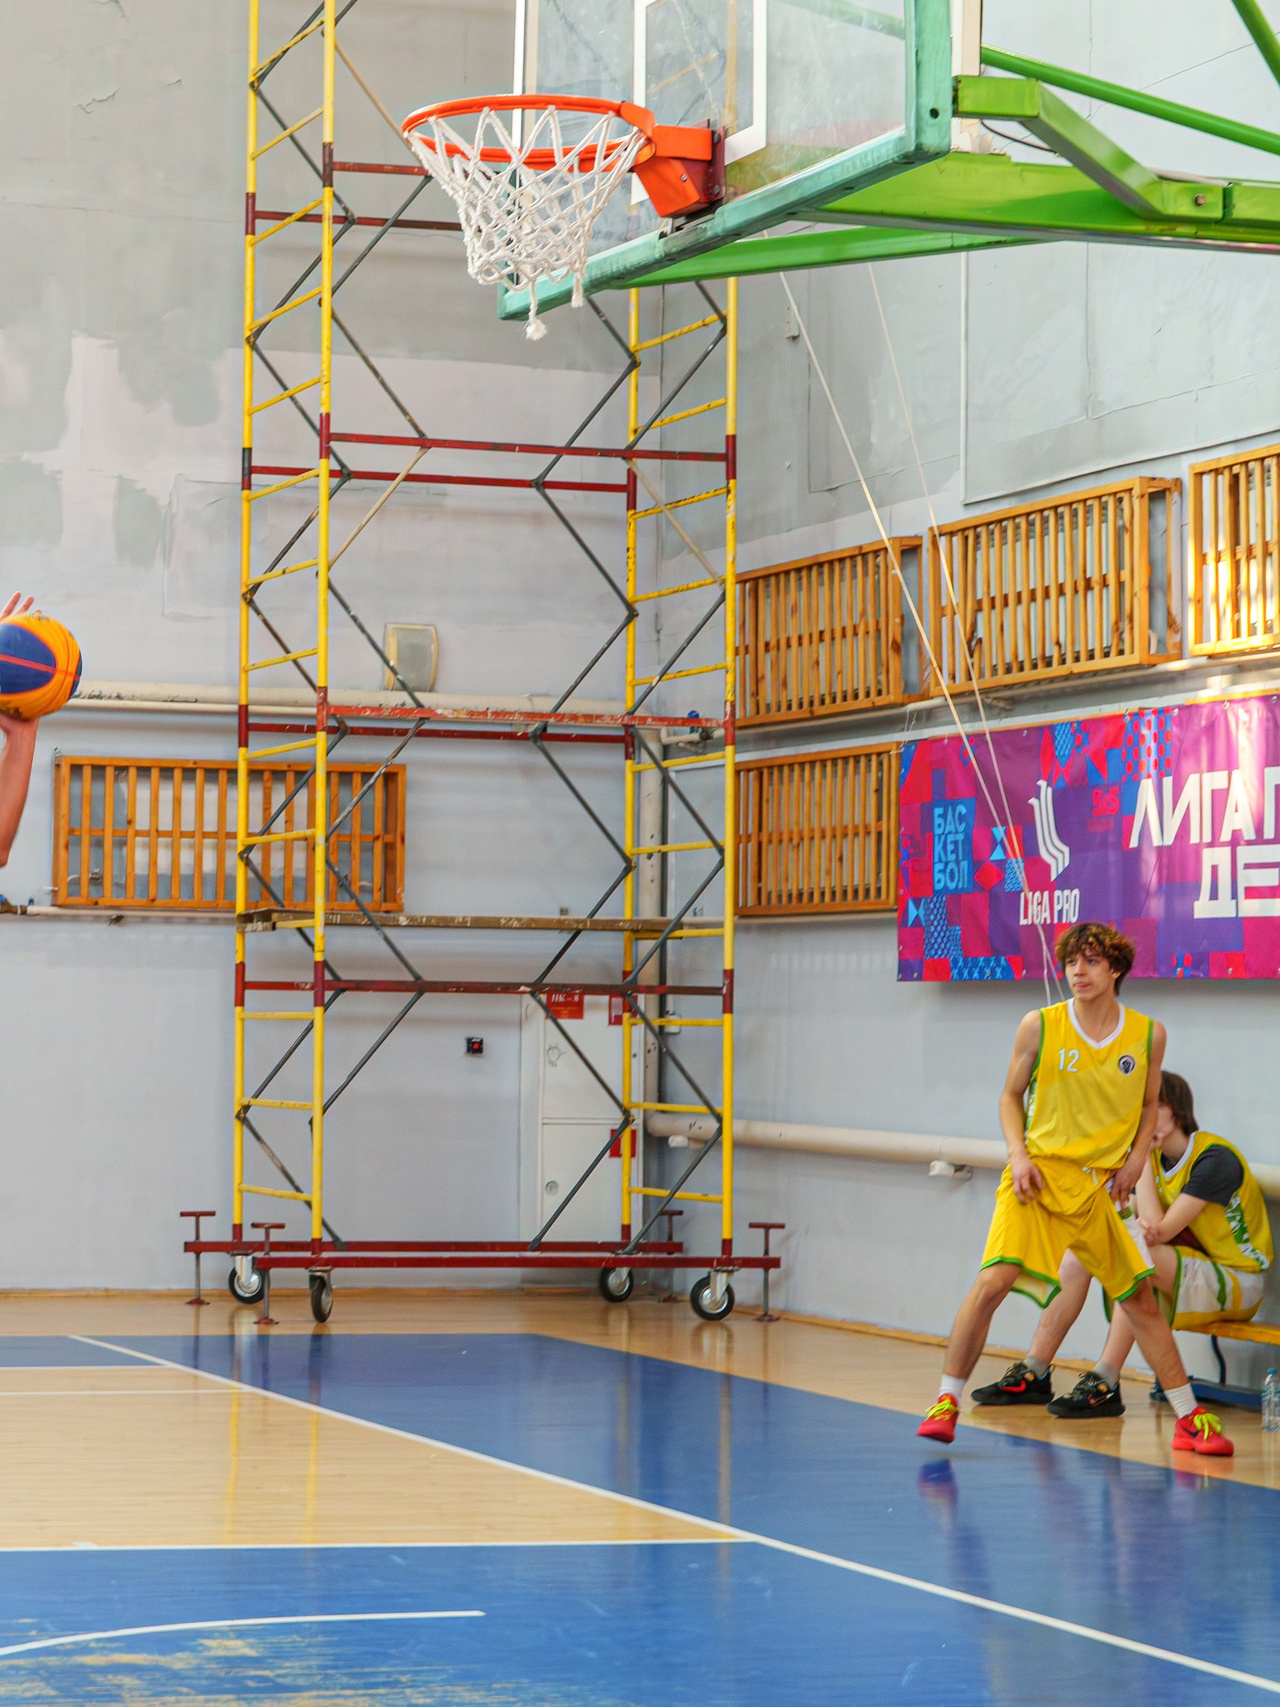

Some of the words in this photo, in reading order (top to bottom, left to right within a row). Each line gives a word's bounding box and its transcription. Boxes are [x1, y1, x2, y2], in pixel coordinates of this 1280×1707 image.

[933, 804, 967, 835] БАС
[1129, 769, 1256, 848] ЛИГА
[933, 833, 965, 863] КЕТ
[933, 860, 969, 890] БОЛ
[1019, 890, 1051, 926] LIGA
[1053, 888, 1081, 925] PRO
[1058, 1047, 1080, 1072] 12
